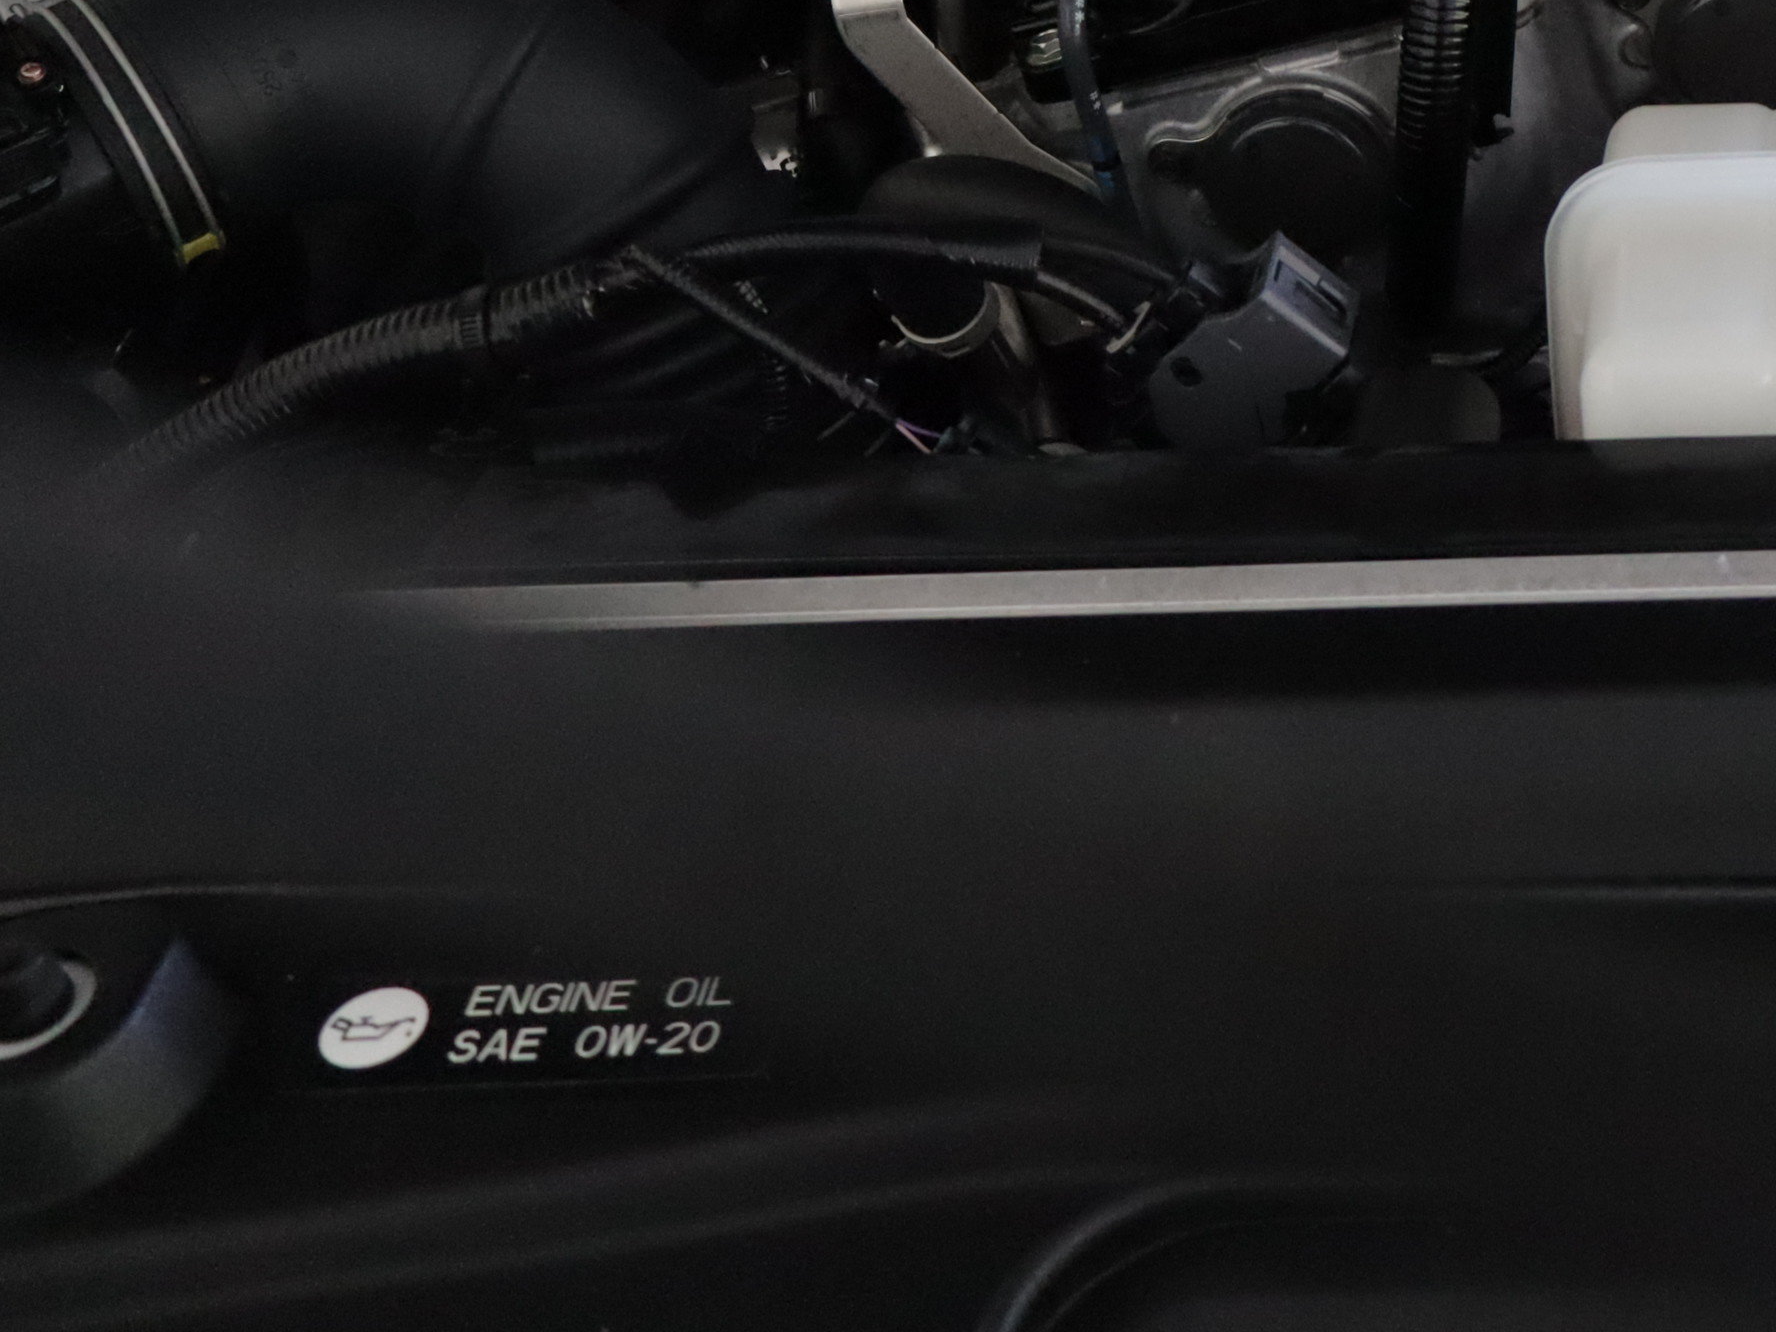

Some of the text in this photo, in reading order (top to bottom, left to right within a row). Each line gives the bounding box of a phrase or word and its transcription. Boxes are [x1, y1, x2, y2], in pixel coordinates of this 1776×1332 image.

[464, 975, 732, 1017] ENGINE OIL
[447, 1020, 721, 1063] SAE 0W-20
